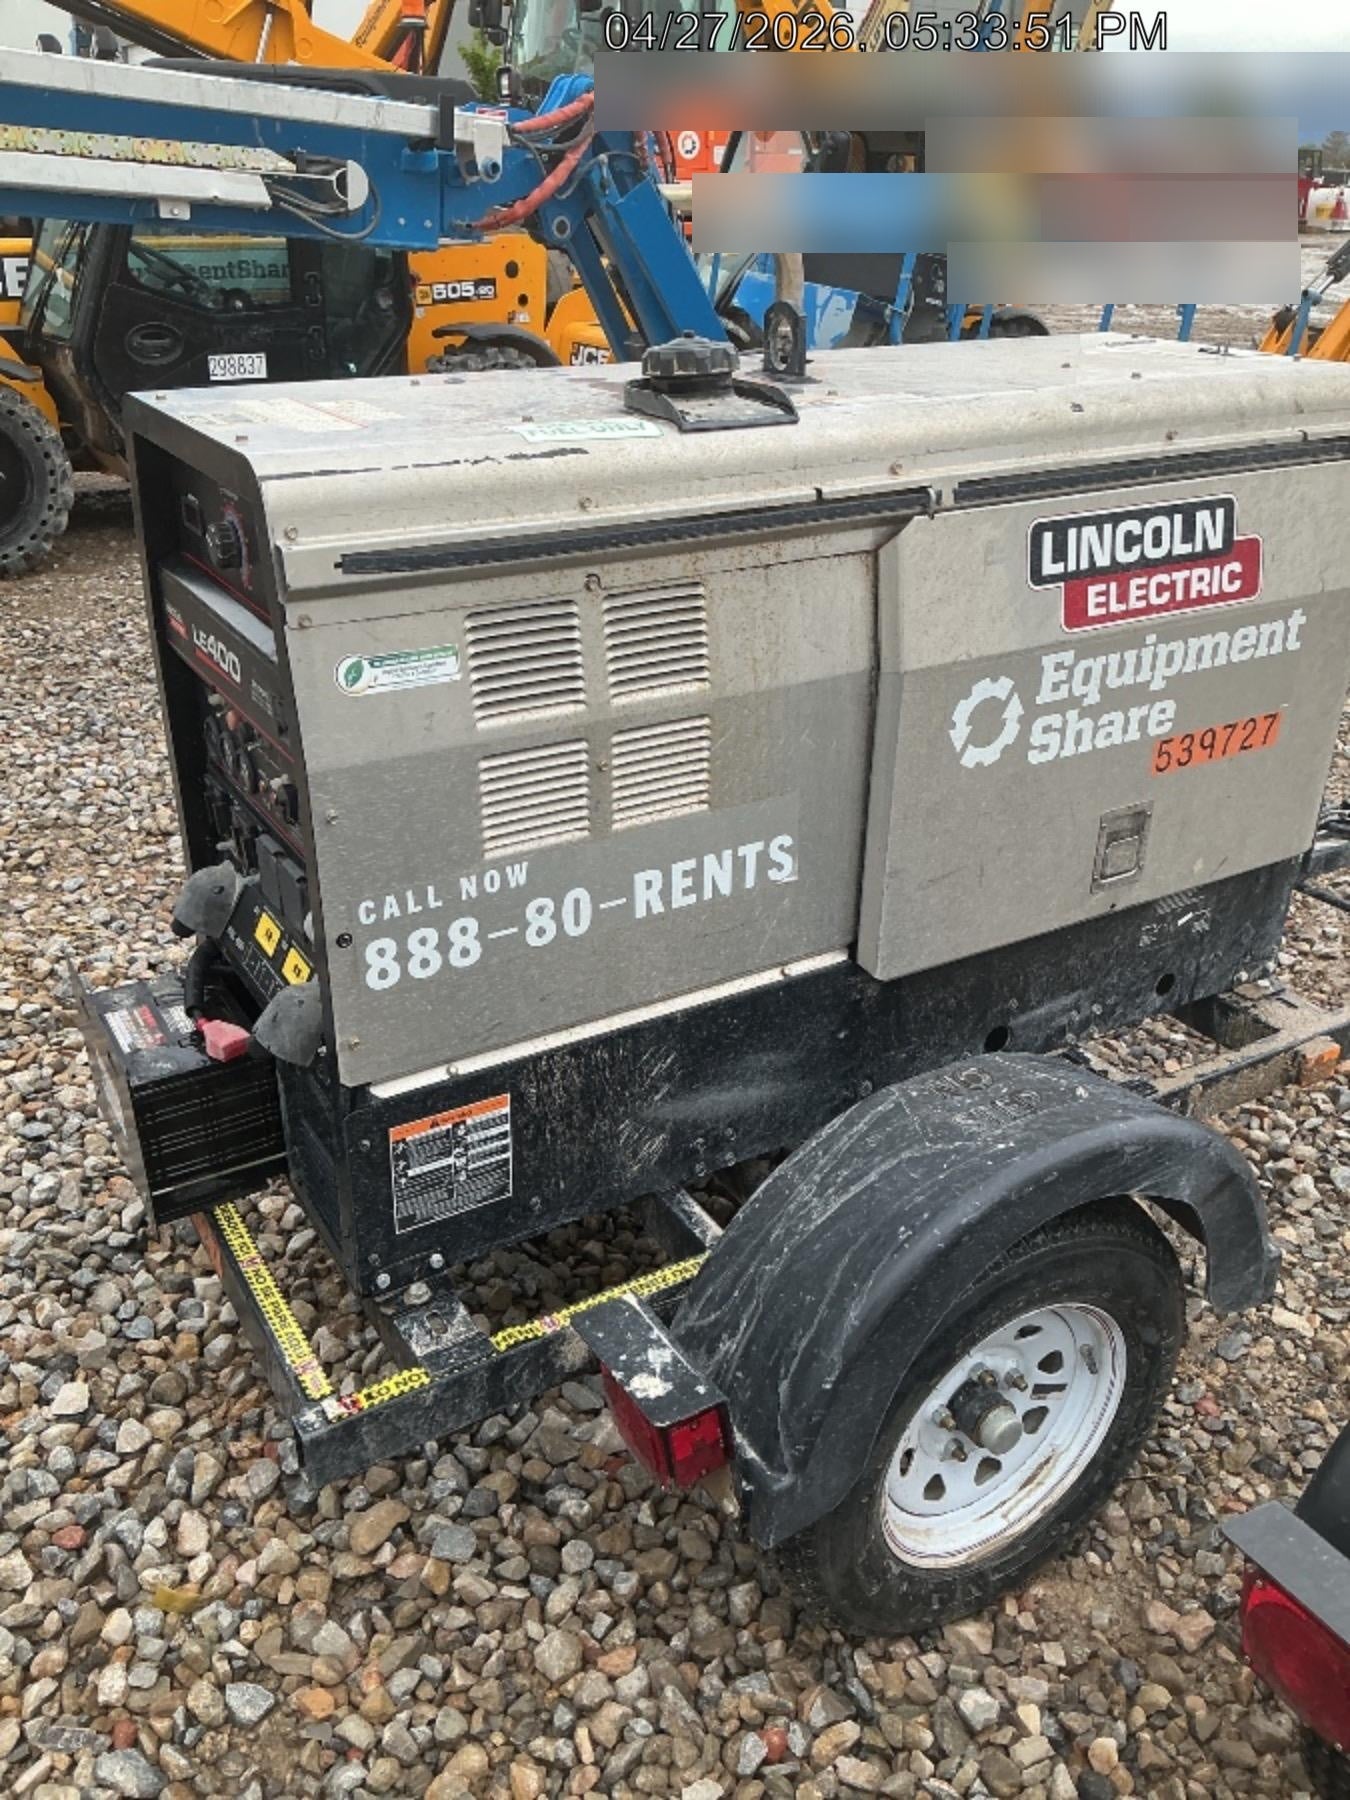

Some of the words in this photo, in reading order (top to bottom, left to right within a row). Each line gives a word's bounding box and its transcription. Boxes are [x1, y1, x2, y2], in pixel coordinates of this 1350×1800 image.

[209, 355, 264, 378] 298837
[1040, 508, 1226, 575] LINCOLN
[1086, 561, 1243, 617] ELECTRIC
[1034, 608, 1308, 705] Equipment
[1026, 699, 1177, 765] Share
[1154, 712, 1281, 775] 539727
[357, 886, 444, 928] CALL
[459, 861, 531, 901] NOW
[363, 833, 797, 991] 888-80-RENTS
